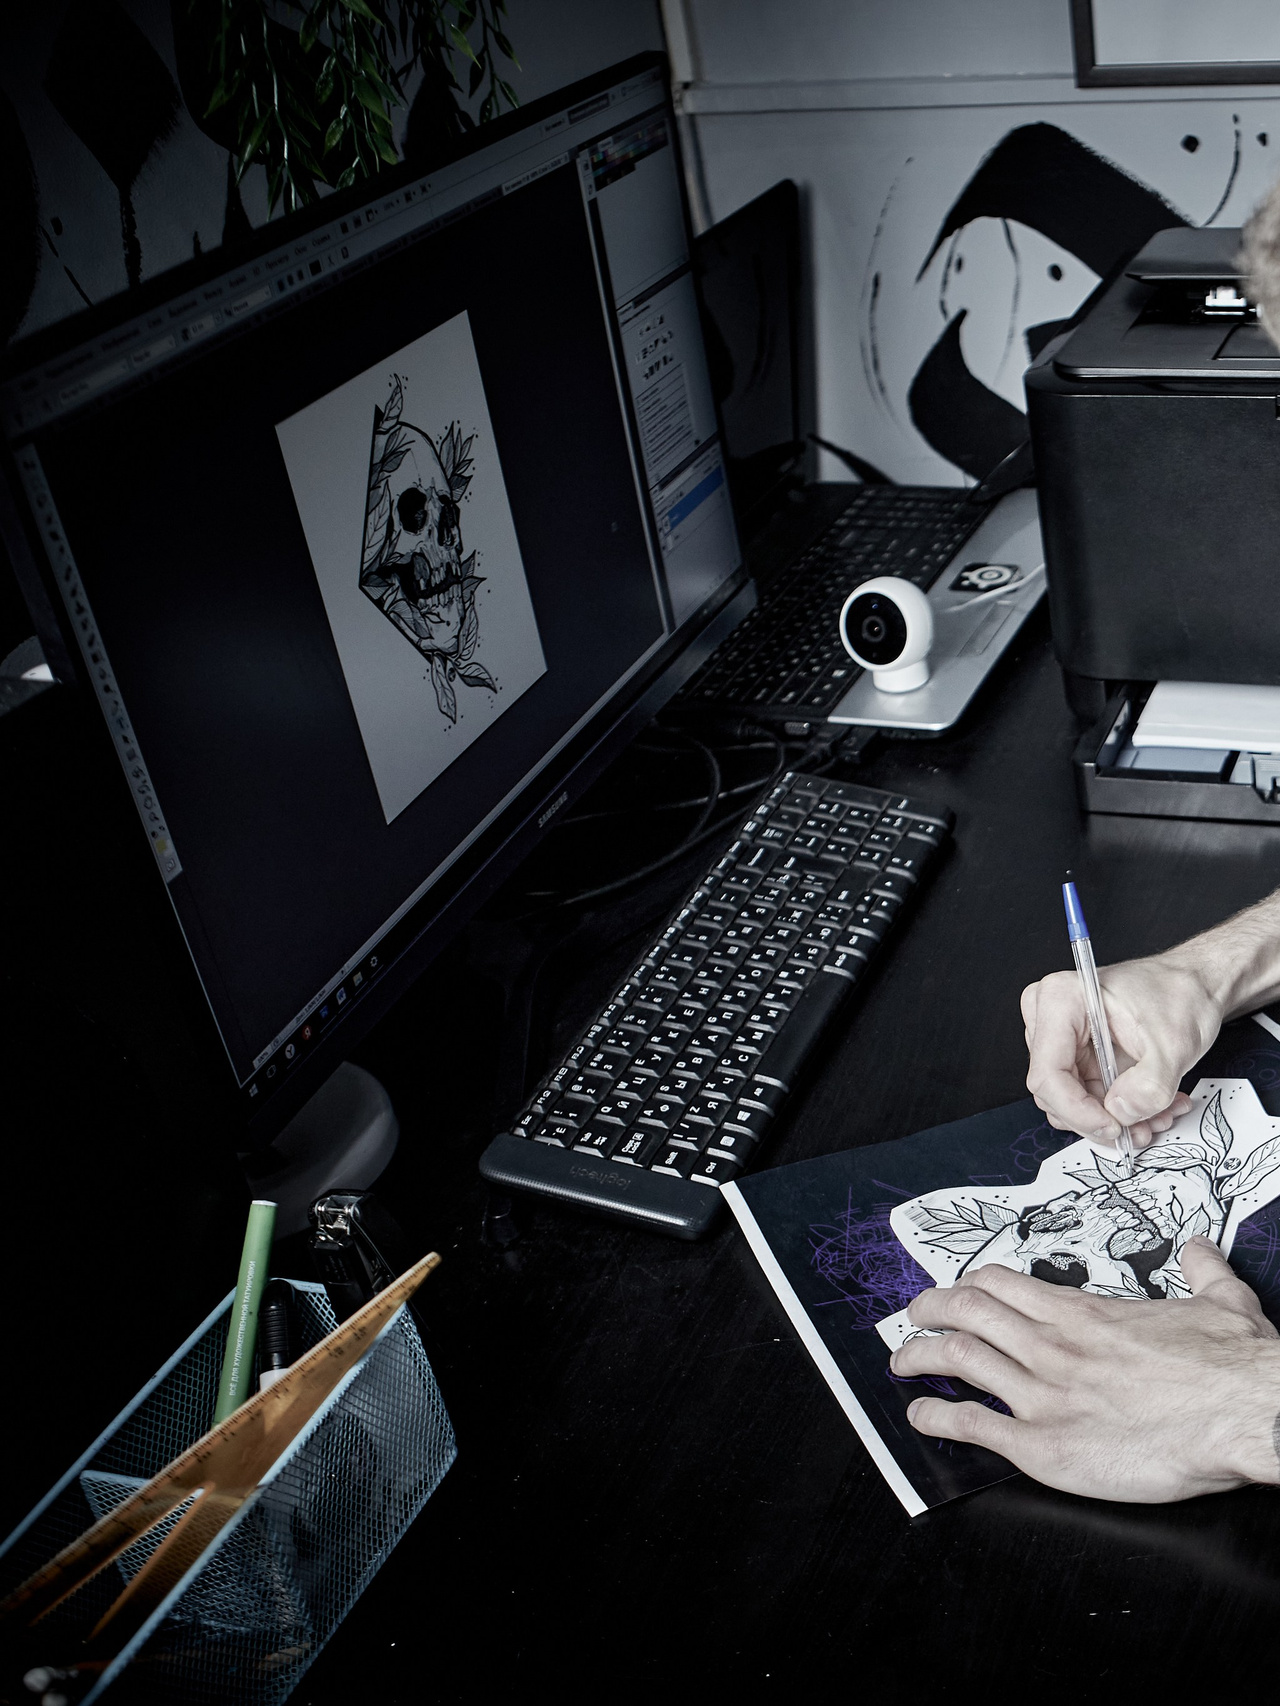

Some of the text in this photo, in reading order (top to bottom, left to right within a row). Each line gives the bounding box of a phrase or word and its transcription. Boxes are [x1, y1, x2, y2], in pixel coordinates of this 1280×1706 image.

[674, 1079, 687, 1088] Ы
[569, 1165, 632, 1191] logitech
[242, 1260, 257, 1303] ТАТУИРОВКИ
[232, 1303, 251, 1367] ХУДОЖЕСТВЕННОЙ
[230, 1367, 241, 1382] ДЛЯ
